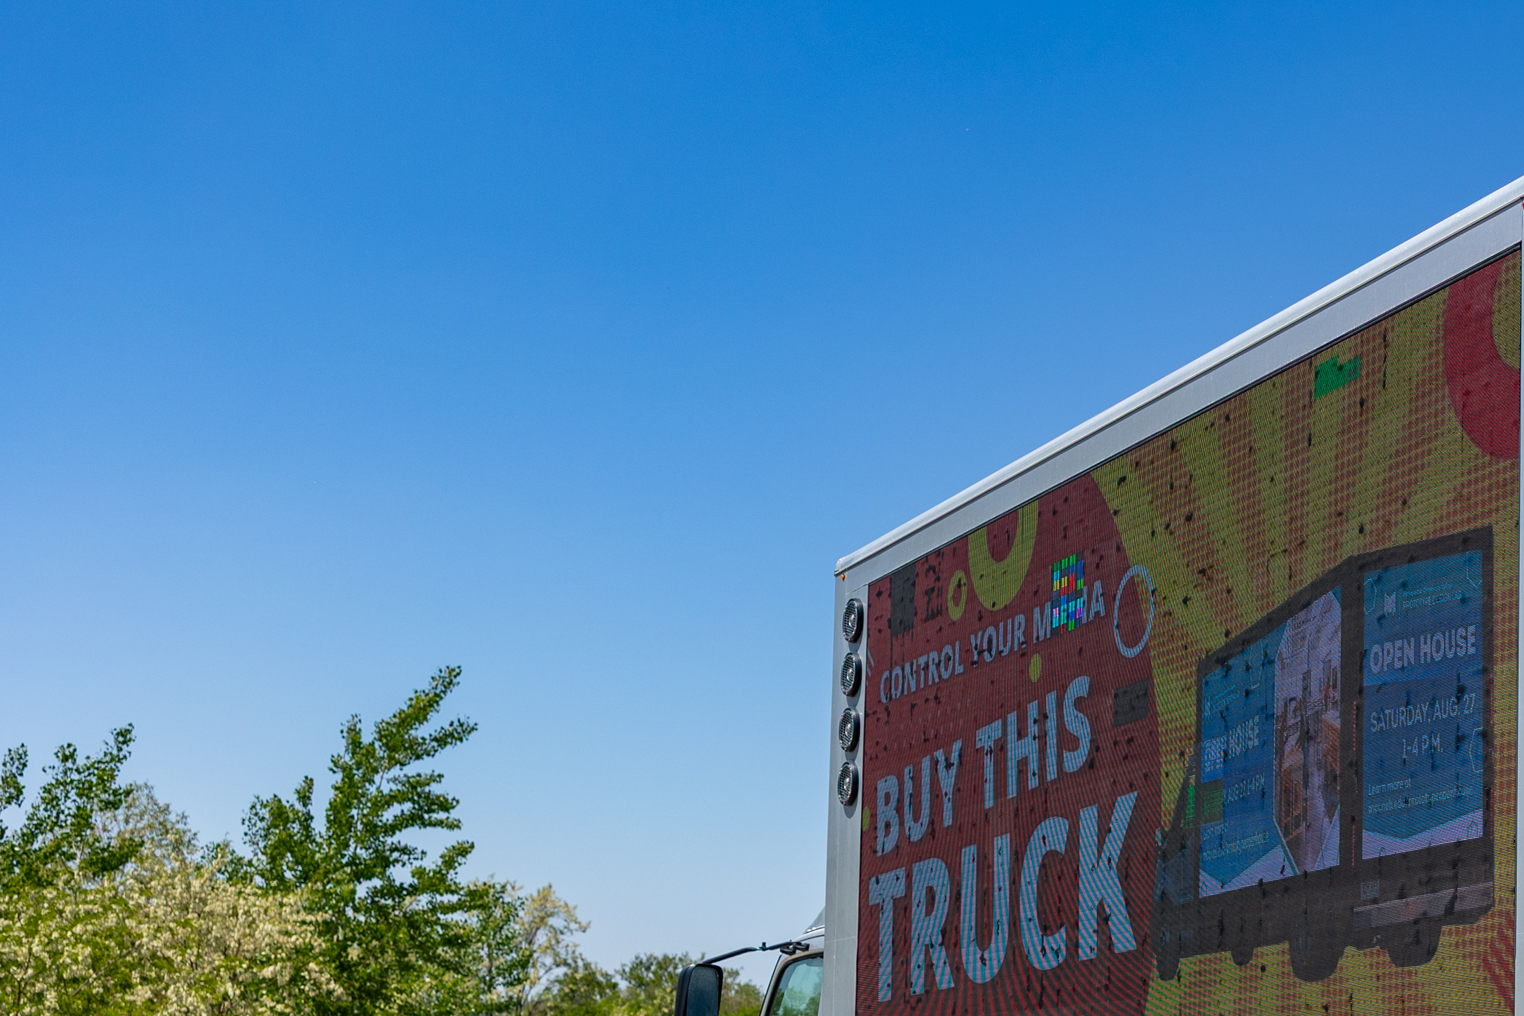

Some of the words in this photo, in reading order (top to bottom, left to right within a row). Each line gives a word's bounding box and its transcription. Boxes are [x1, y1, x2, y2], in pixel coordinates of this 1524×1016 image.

[880, 640, 964, 704] CONTROL
[970, 613, 1027, 668] YOUR
[1370, 637, 1415, 674] OPEN
[1420, 625, 1476, 663] HOUSE
[1463, 693, 1476, 715] 27
[876, 738, 962, 857] BUY
[975, 675, 1091, 809] THIS
[869, 790, 1138, 1002] TRUCK
